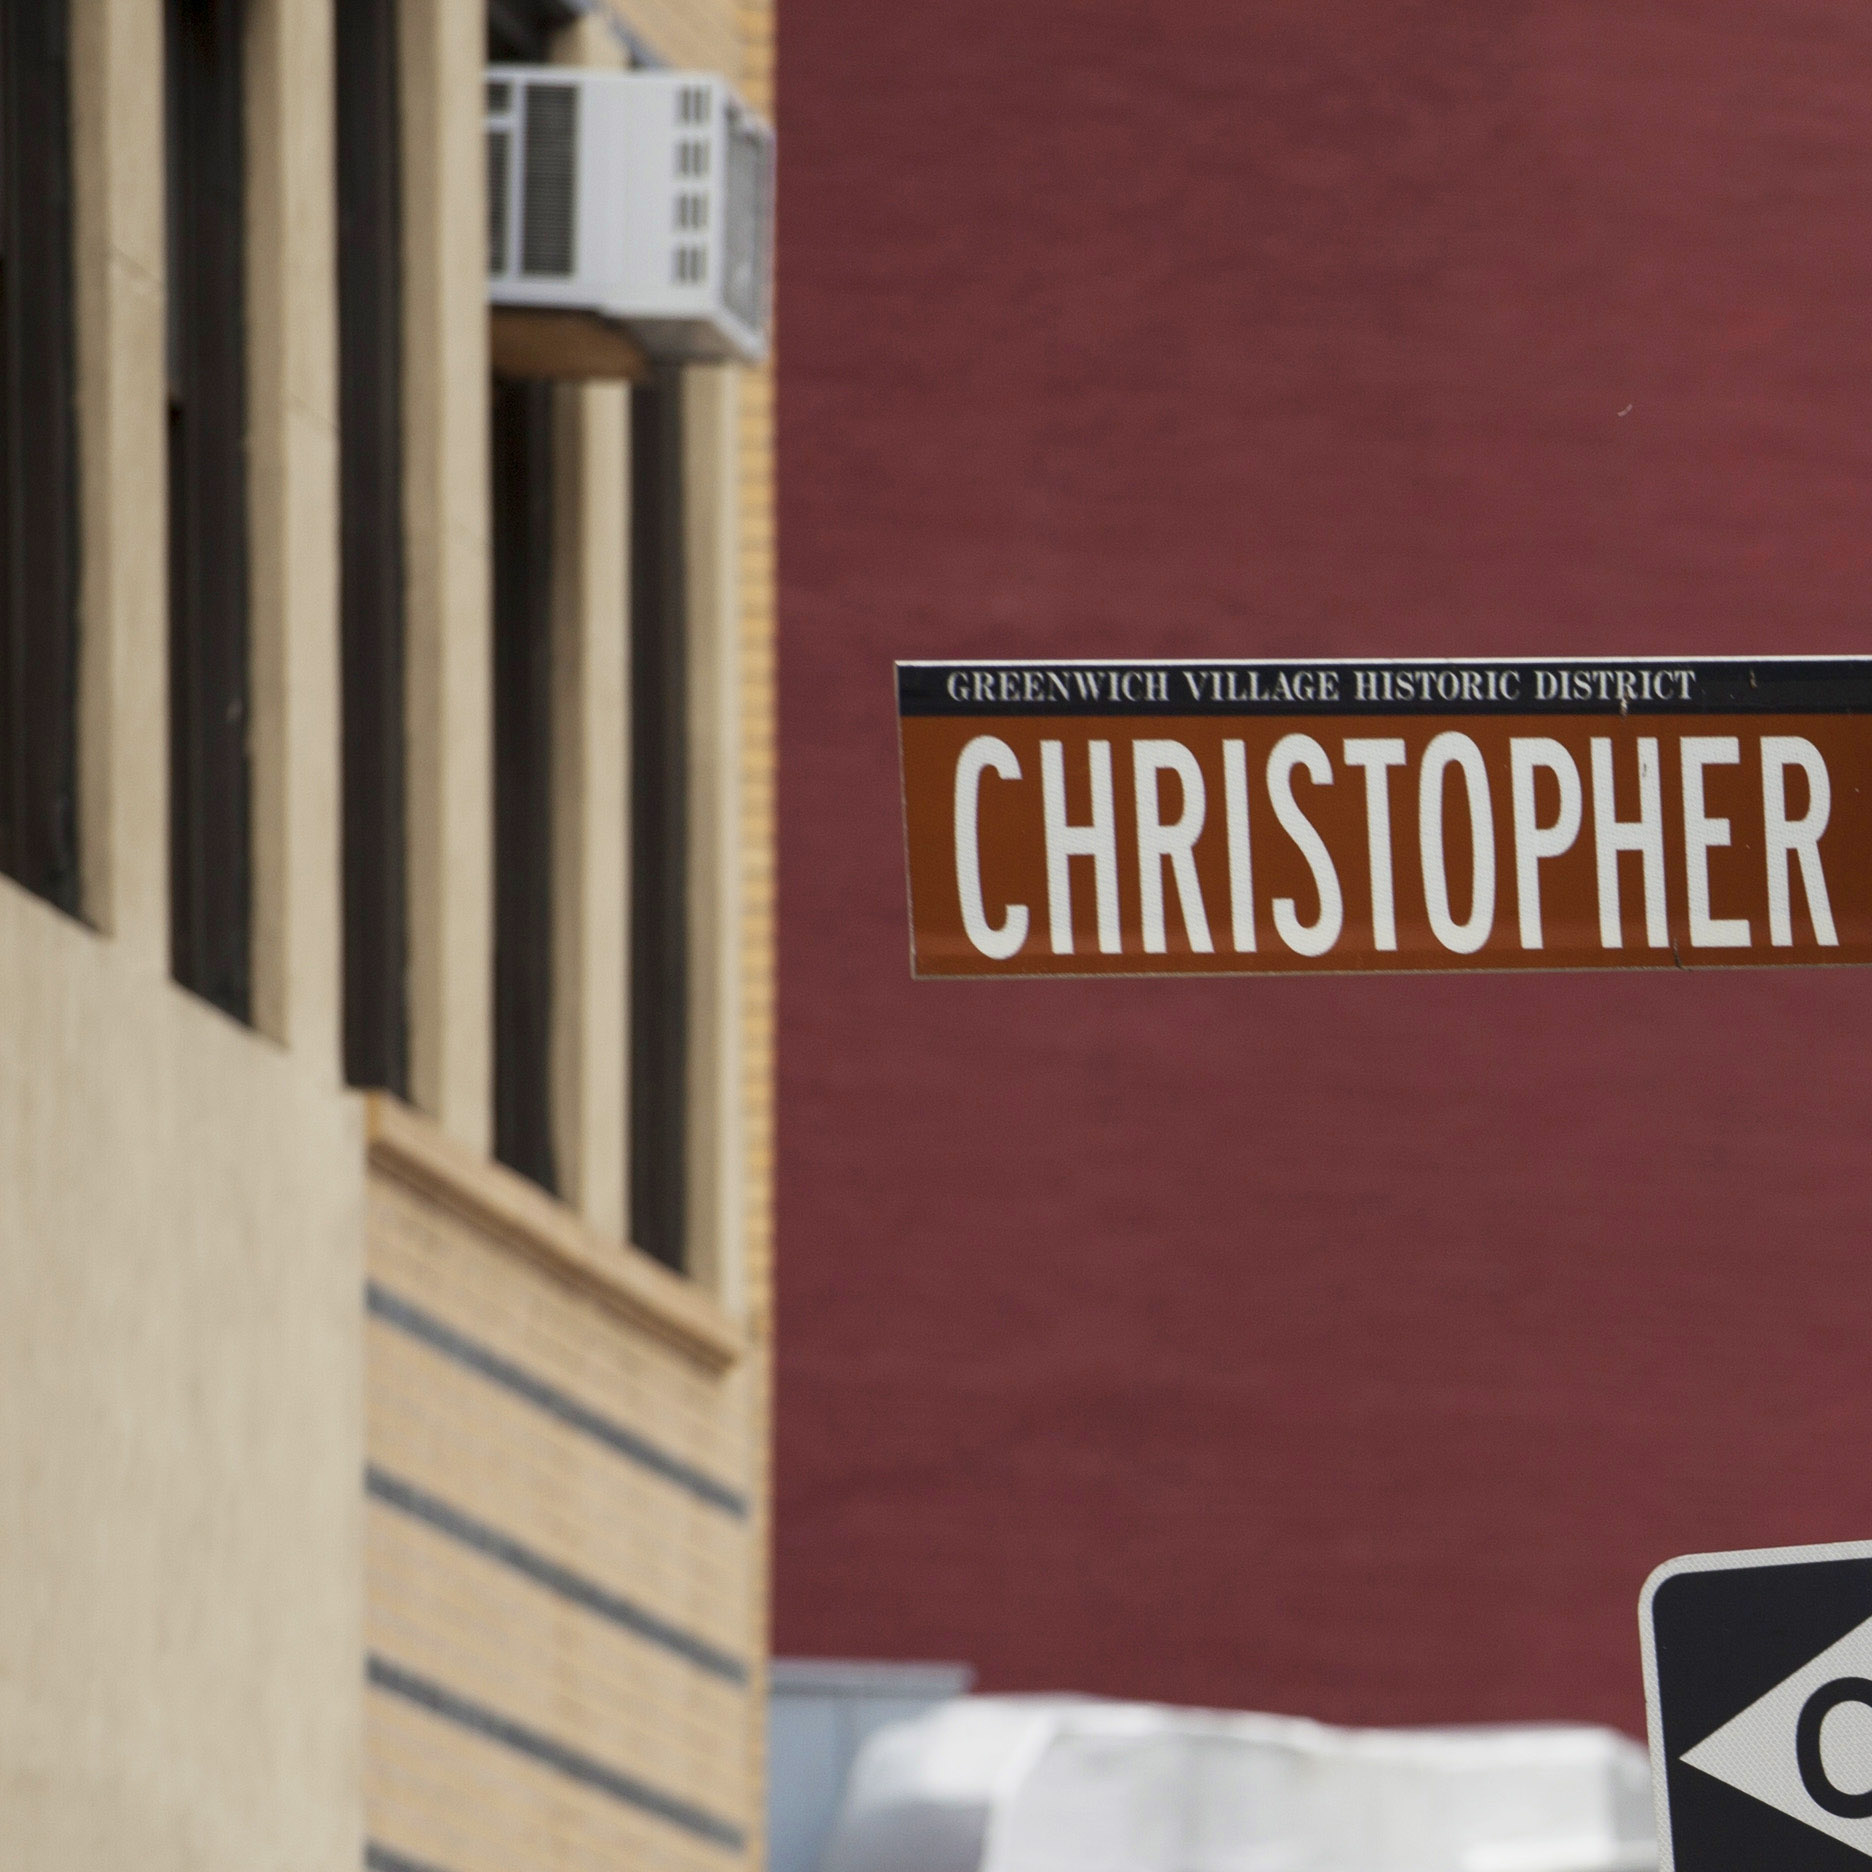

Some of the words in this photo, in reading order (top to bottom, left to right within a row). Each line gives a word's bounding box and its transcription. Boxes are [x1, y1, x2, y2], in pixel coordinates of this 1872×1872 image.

[946, 672, 1169, 703] GREENWICH
[1182, 671, 1340, 702] VILLAGE
[1354, 670, 1521, 701] HISTORIC
[1534, 668, 1696, 701] DISTRICT
[952, 729, 1841, 960] CHRISTOPHER
